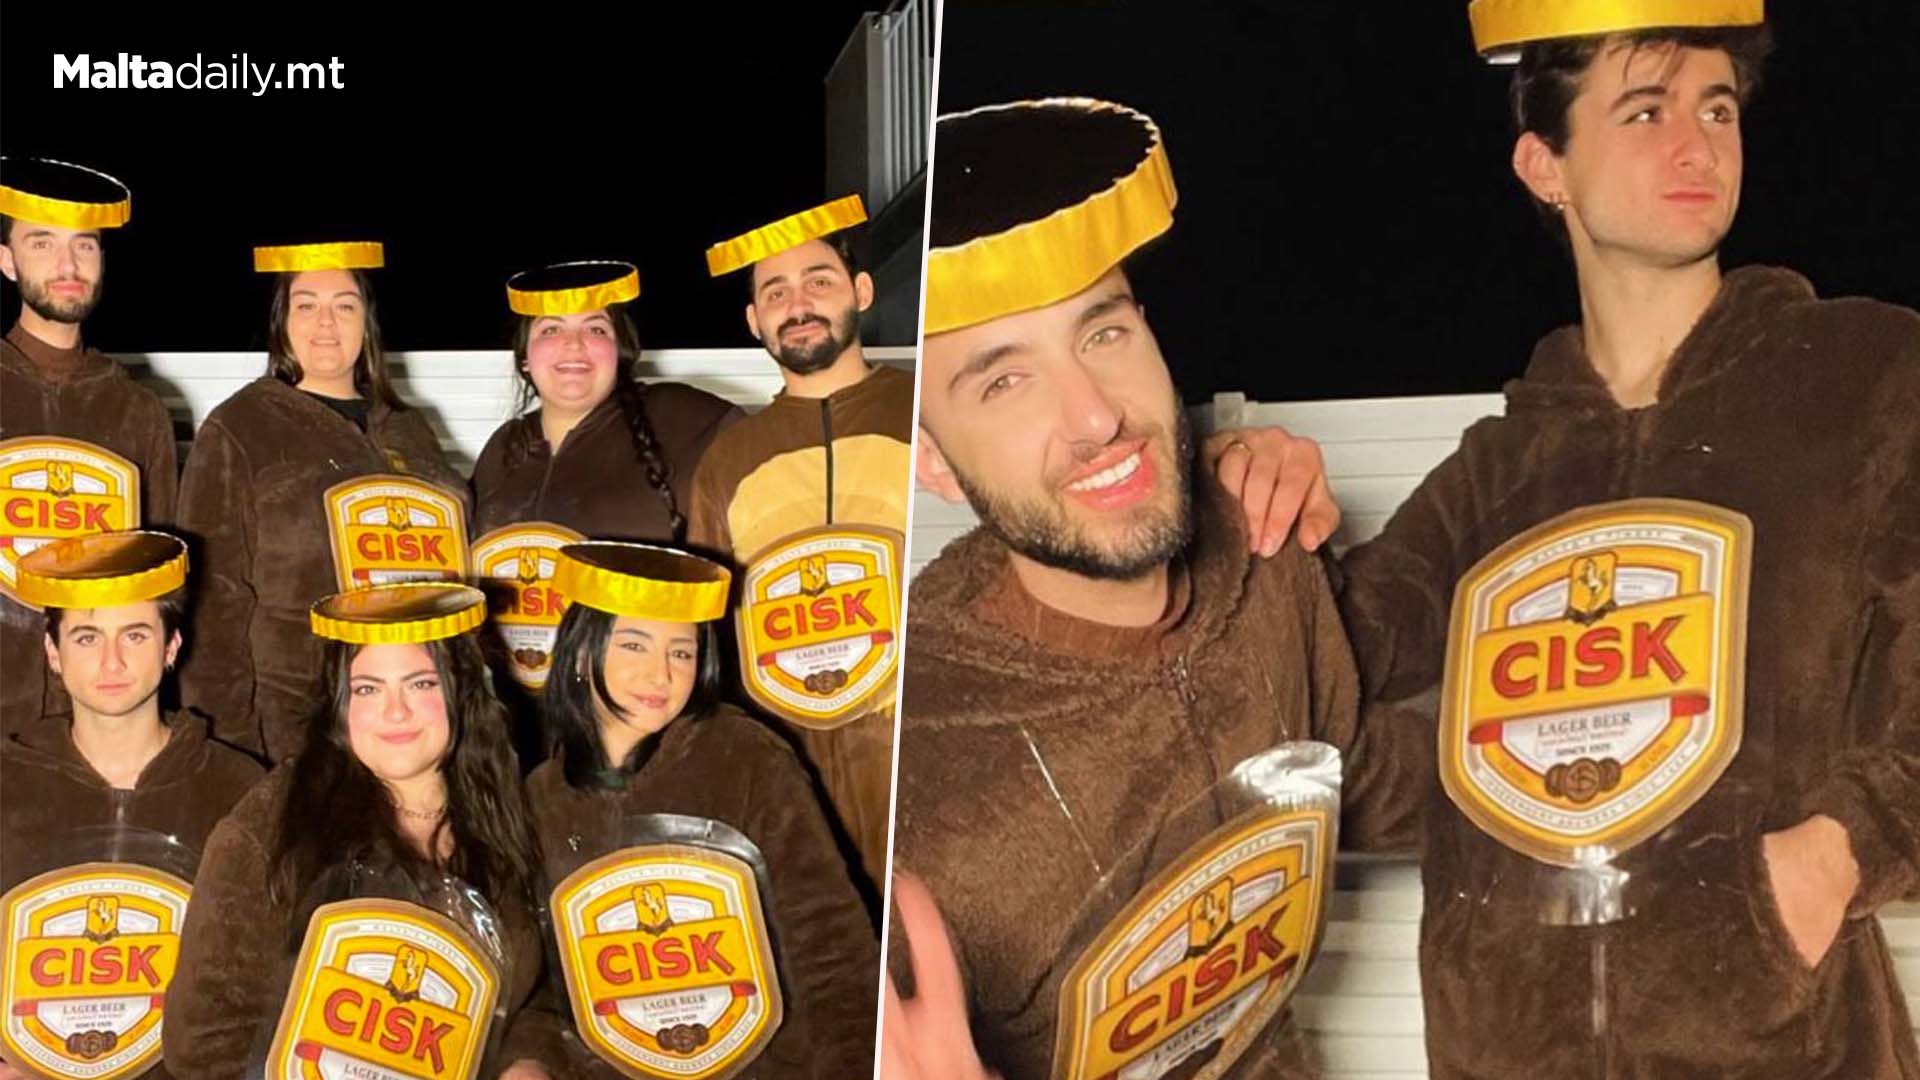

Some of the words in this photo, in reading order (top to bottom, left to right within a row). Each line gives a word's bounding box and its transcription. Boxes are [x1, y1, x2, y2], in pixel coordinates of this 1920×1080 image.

[5, 497, 112, 533] CISK
[357, 532, 448, 566] CISK
[763, 588, 877, 640] CISK
[1490, 613, 1689, 699] CISK
[1537, 717, 1588, 737] LAGER
[1592, 712, 1633, 729] BEER
[30, 944, 163, 988] CISK
[596, 930, 736, 986] CISK
[1109, 900, 1291, 1054] CISK
[323, 988, 454, 1074] CISK
